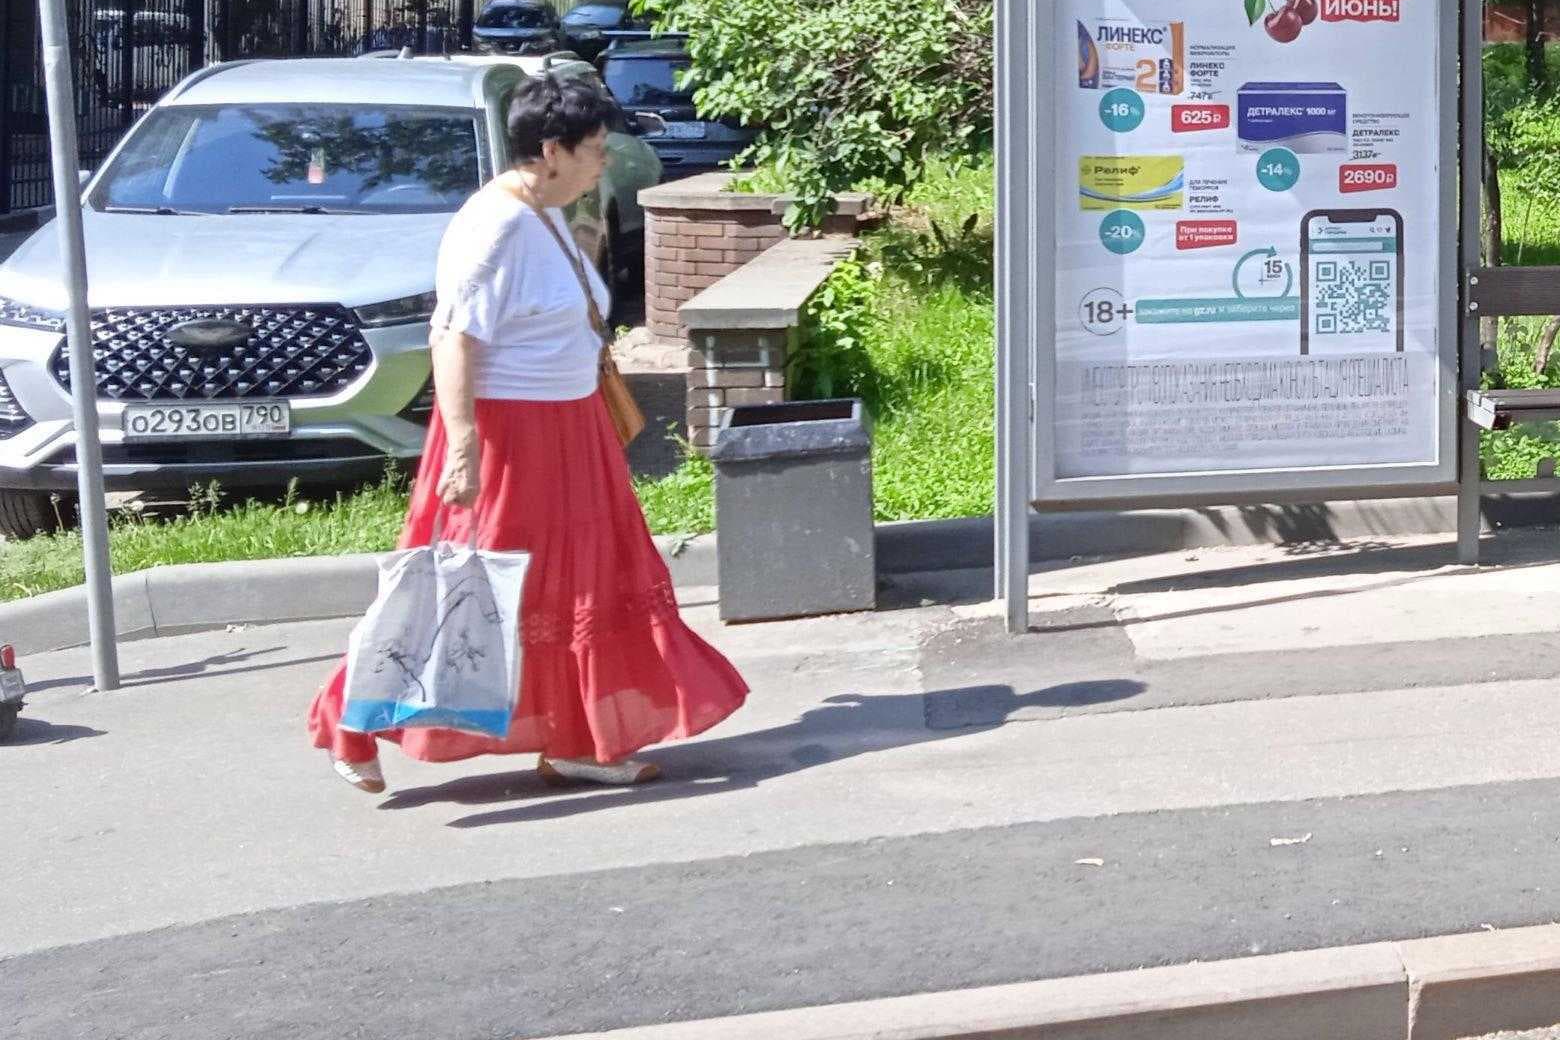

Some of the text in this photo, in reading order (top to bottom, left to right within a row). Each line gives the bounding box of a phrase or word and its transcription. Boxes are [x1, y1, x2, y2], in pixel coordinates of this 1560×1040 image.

[1325, 0, 1398, 17] ИЮНЬ!
[1097, 25, 1163, 45] ЛИНЕКС
[1190, 62, 1225, 70] ЛИНЕКС
[1247, 107, 1304, 118] ДЕТРАЛЕКС
[1352, 129, 1400, 137] ДЕТРАЛЕКС
[1264, 260, 1282, 274] 15
[1083, 301, 1134, 324] 18+
[132, 405, 282, 433] О293ОВ 790
